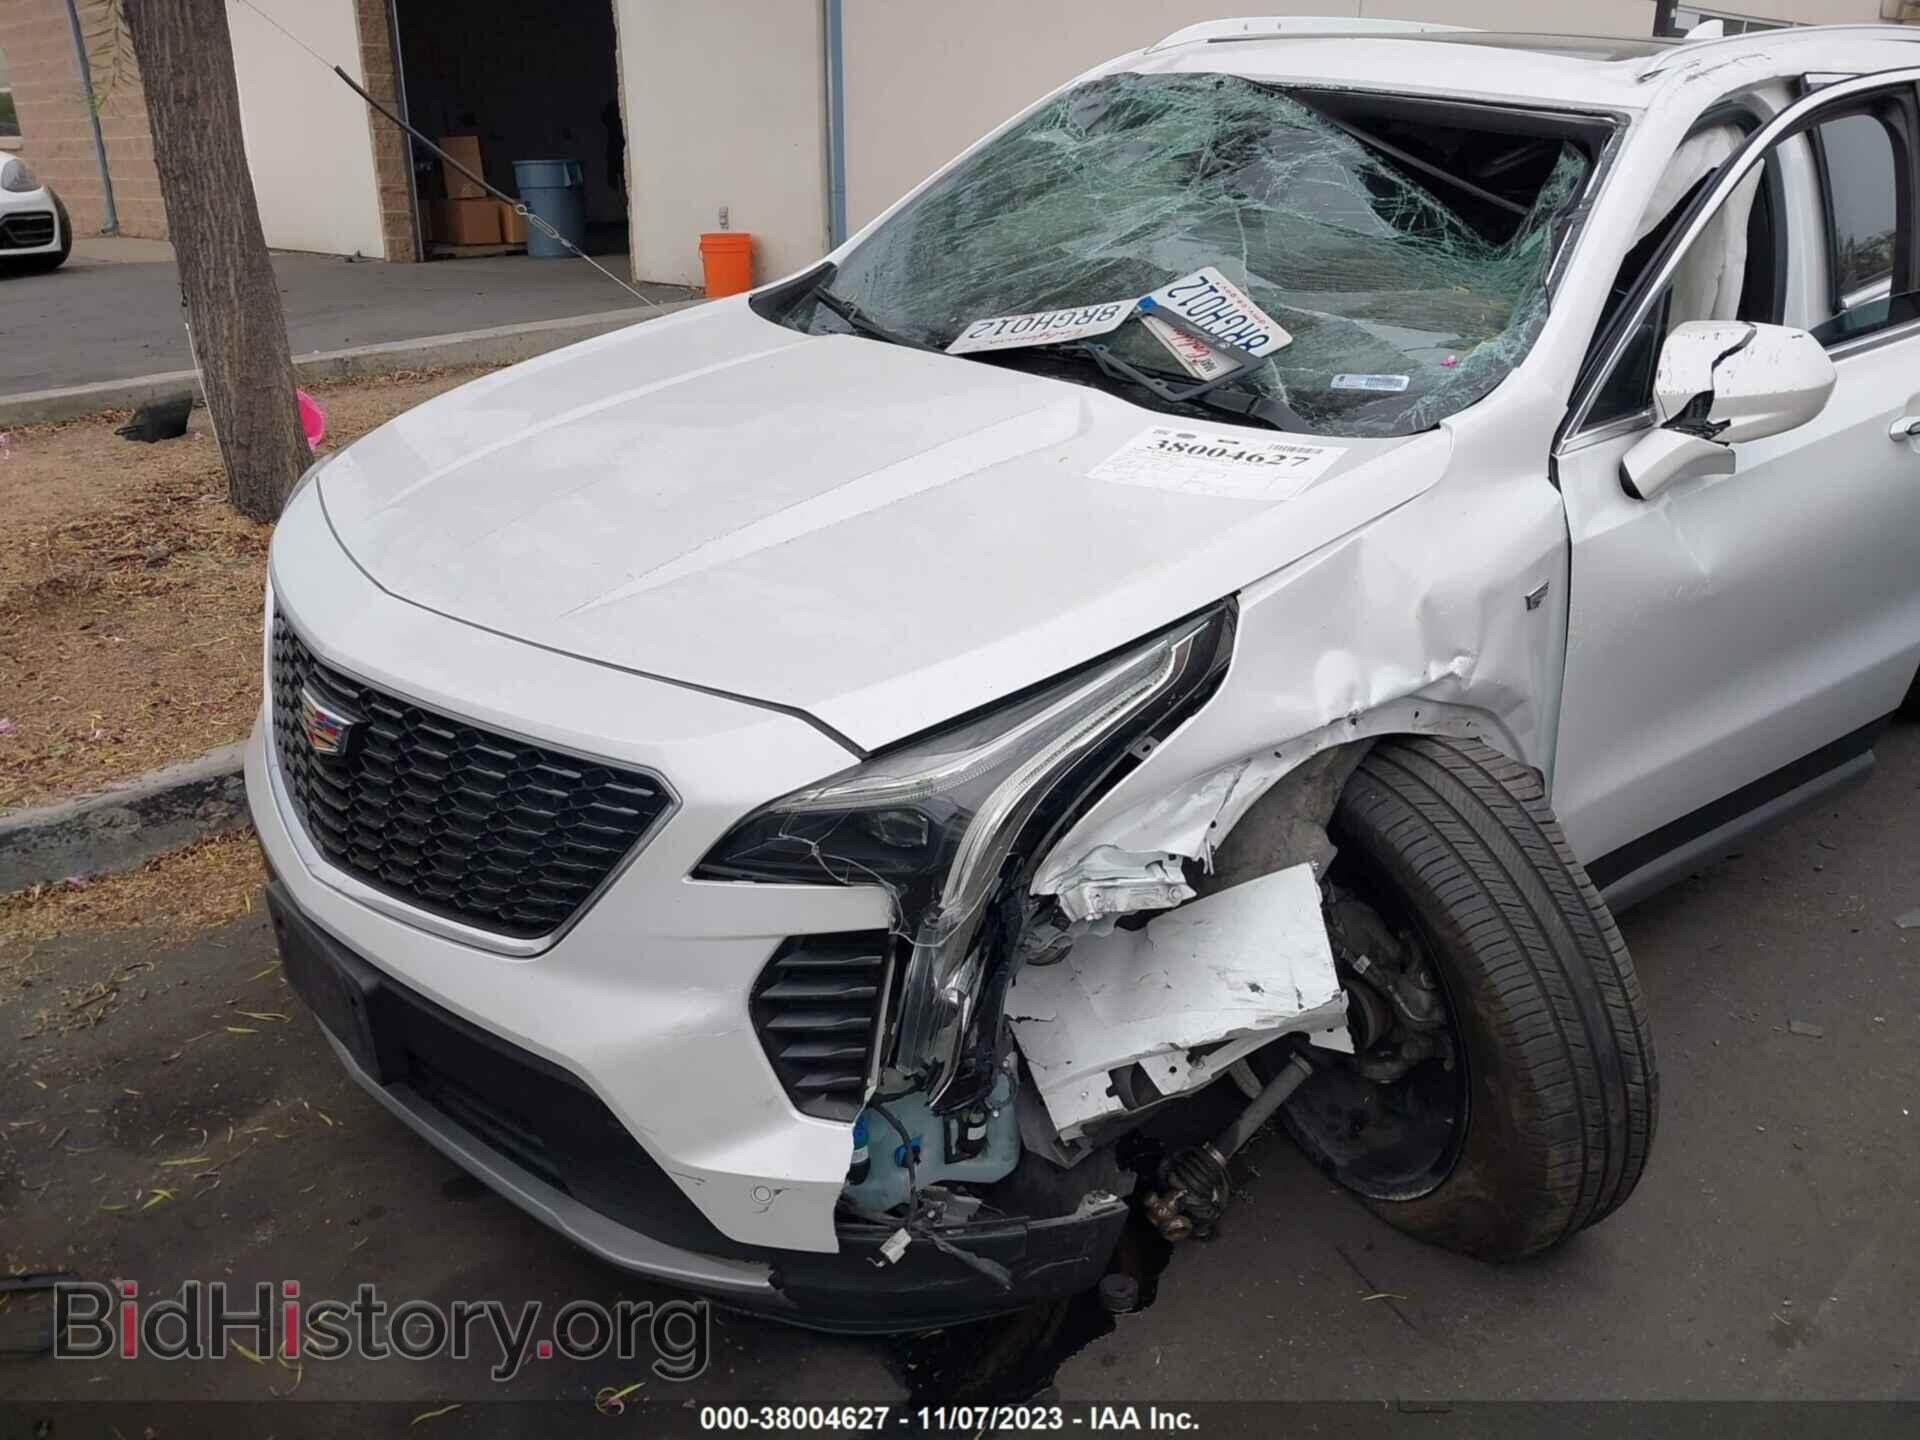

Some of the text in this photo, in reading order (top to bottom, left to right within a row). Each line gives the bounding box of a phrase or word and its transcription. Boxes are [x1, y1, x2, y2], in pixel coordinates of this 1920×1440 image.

[968, 304, 1122, 339] 8RGH012
[1167, 275, 1270, 352] 8RGH012
[1146, 439, 1310, 467] 38004627
